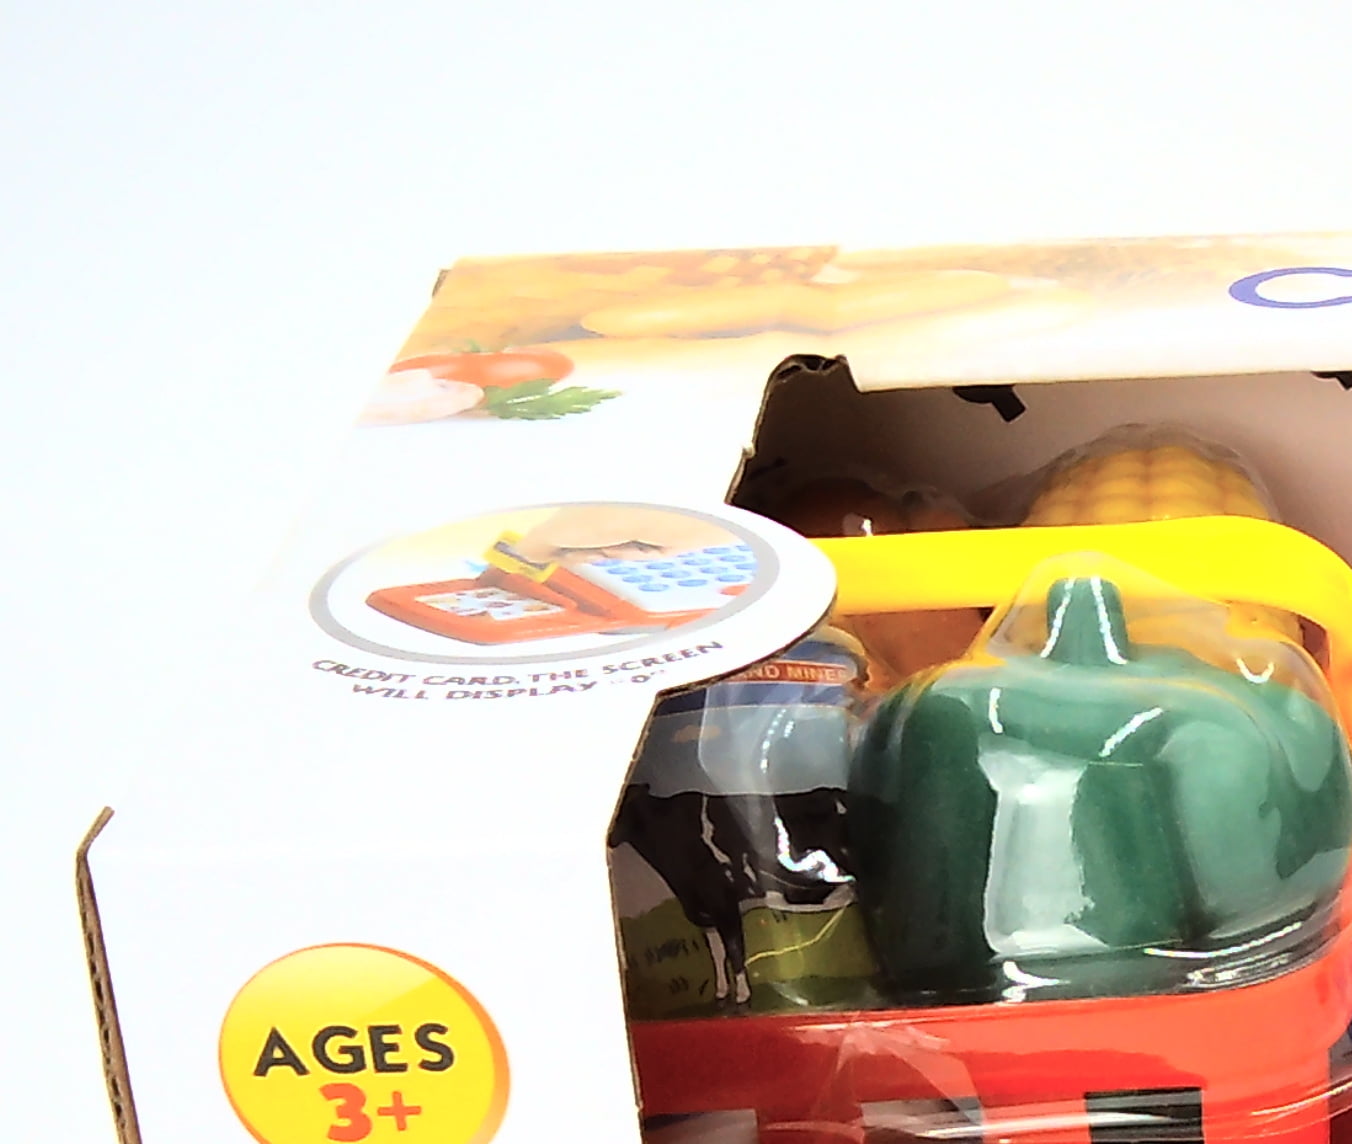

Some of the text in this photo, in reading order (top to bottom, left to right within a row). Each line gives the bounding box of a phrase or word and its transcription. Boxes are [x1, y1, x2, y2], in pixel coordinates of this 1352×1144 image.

[312, 658, 418, 684] CREDIT
[527, 667, 590, 684] THE
[601, 639, 724, 676] SCREEN
[351, 682, 430, 701] WILL
[445, 679, 599, 701] DISPLAY
[253, 1022, 455, 1077] AGES
[319, 1082, 423, 1143] 3+
